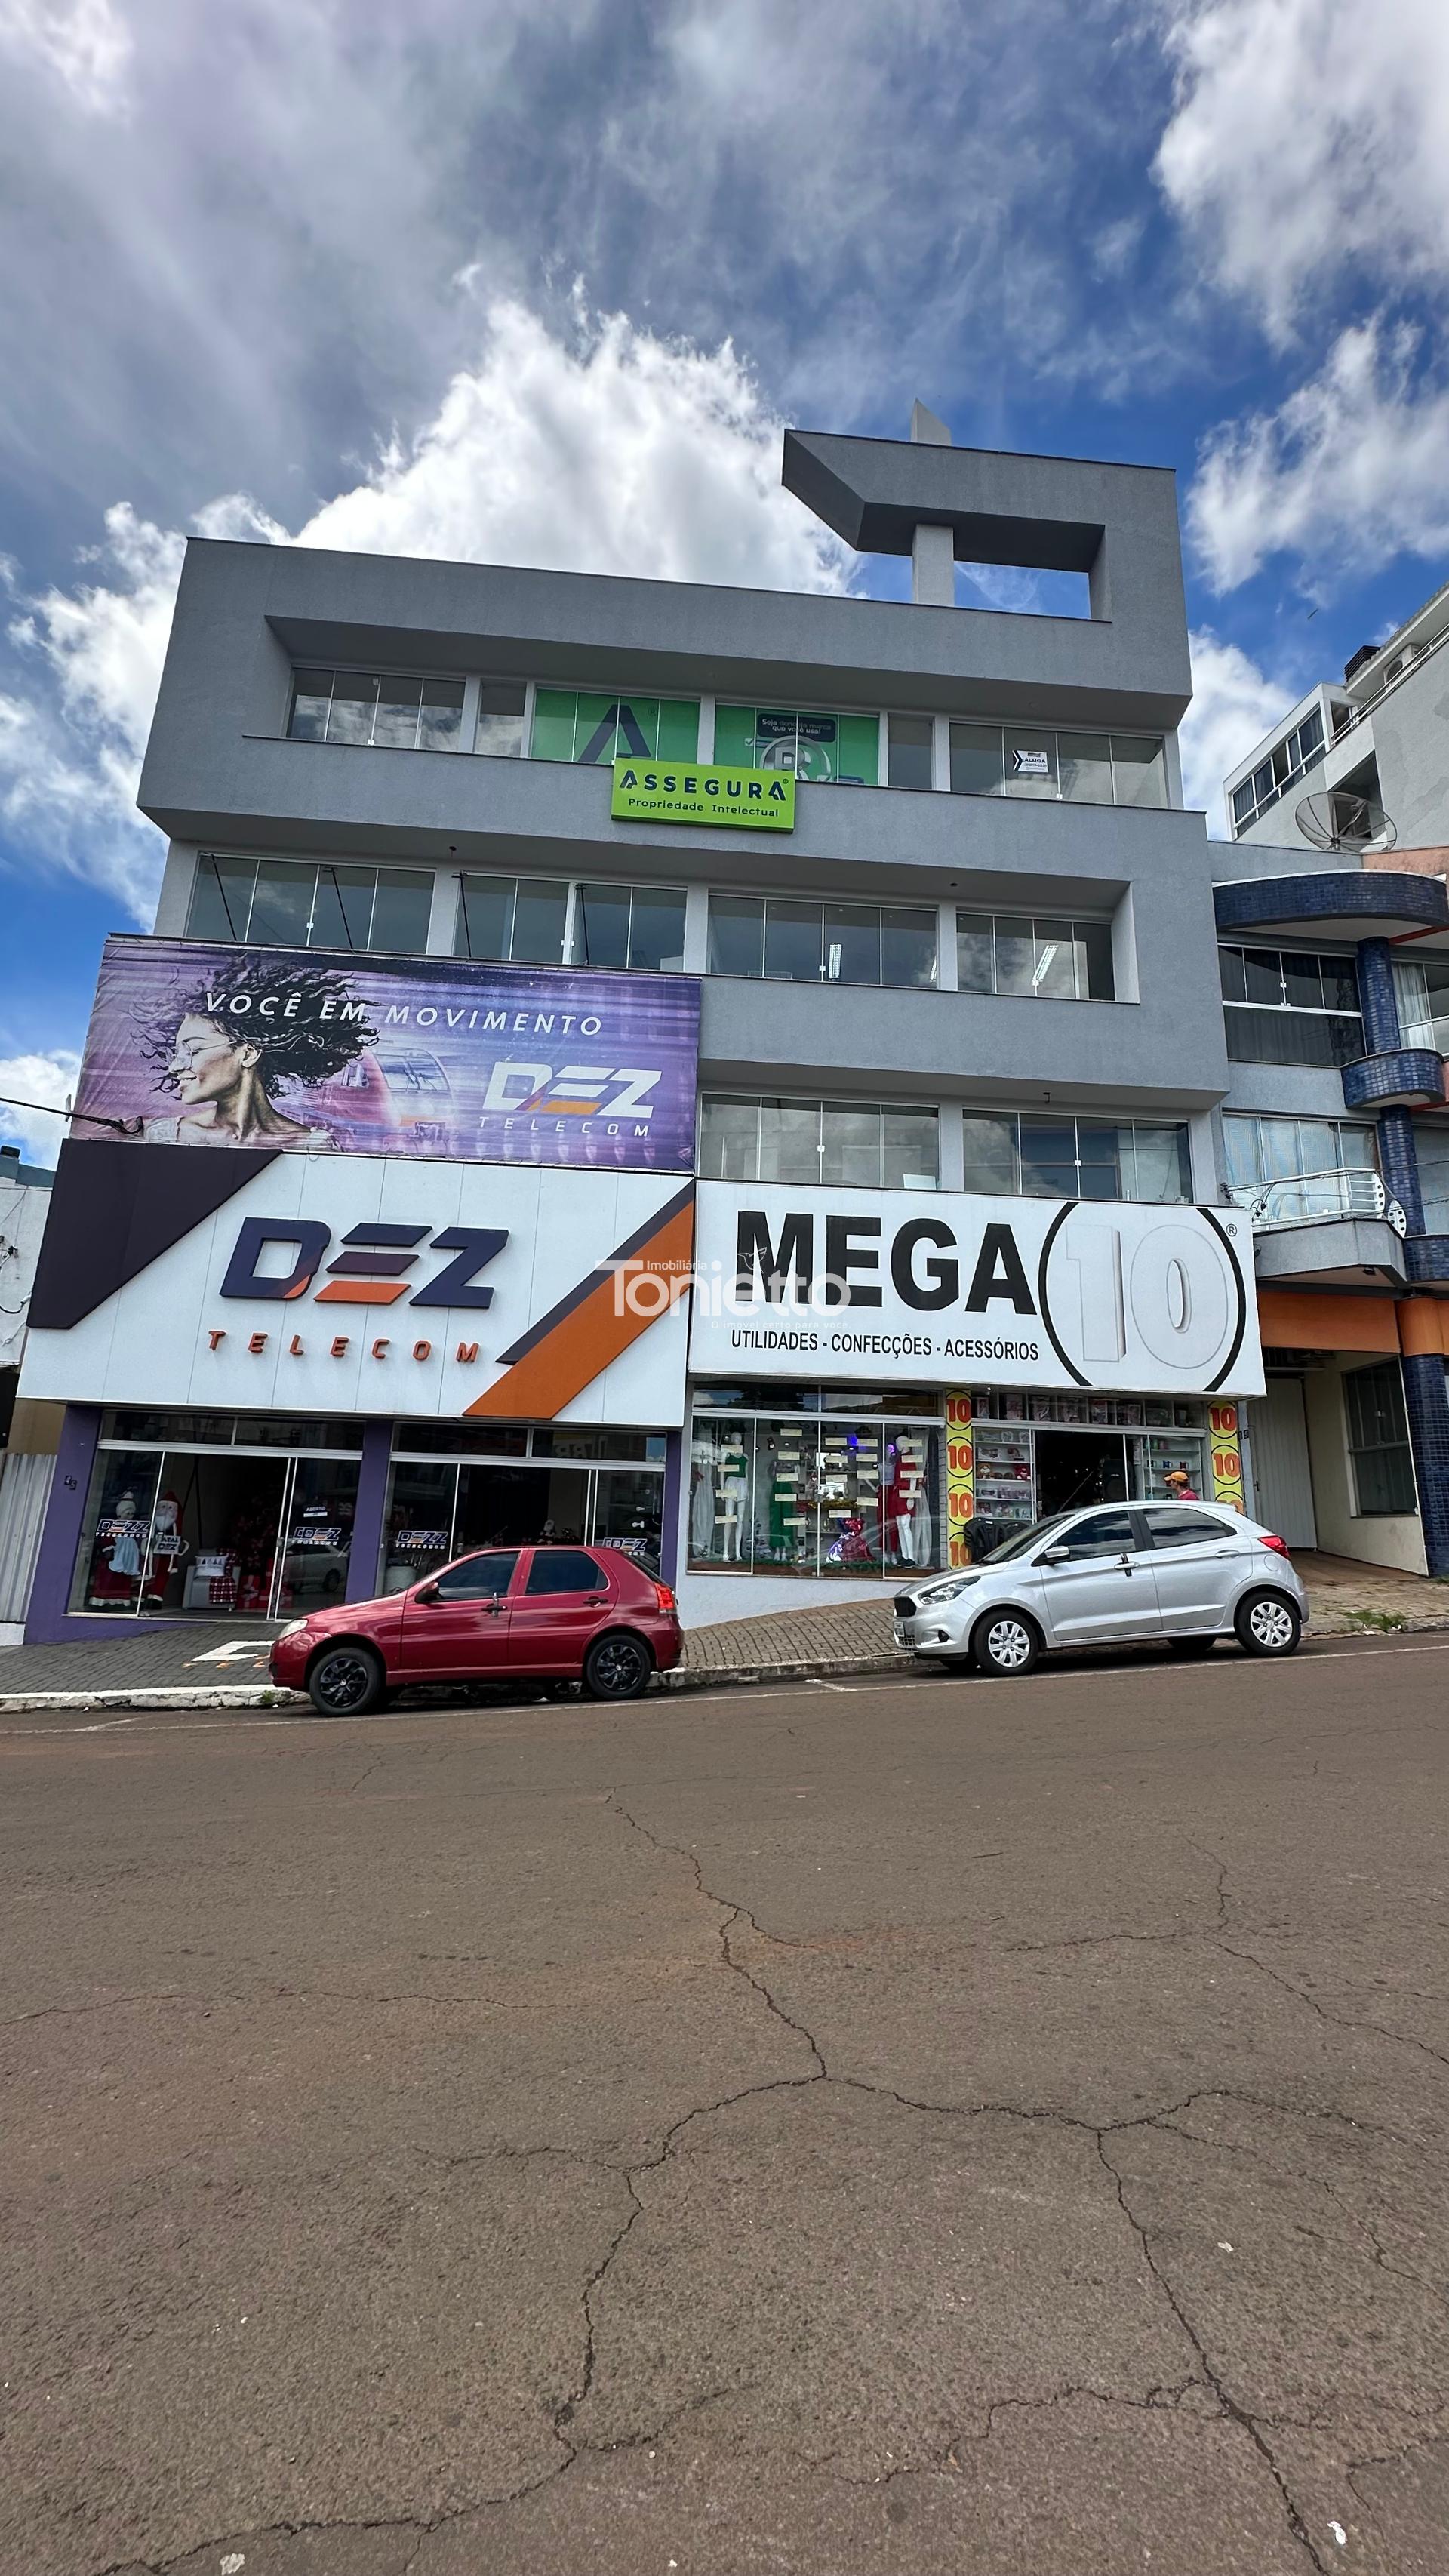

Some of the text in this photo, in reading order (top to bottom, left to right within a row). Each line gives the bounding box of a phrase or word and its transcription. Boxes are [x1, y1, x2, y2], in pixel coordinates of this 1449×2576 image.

[762, 719, 777, 727] Seja
[620, 770, 786, 801] ASSEGURA
[629, 798, 779, 817] Propriedade Intelectual
[206, 991, 602, 1036] VOCÊ EM MOVIMENTO
[482, 1061, 663, 1119] DEZ
[479, 1116, 649, 1137] TELECOM
[219, 1216, 510, 1310] DEZ
[735, 1209, 1038, 1316] MEGA
[1066, 1223, 1229, 1369] 10
[208, 1329, 480, 1363] TELECOM
[731, 1330, 818, 1351] UTILIDADES
[832, 1333, 932, 1359] CONFECÇÕES
[944, 1337, 1039, 1361] ACESSÓRIOS
[947, 1399, 971, 1423] 10
[1210, 1408, 1237, 1431] 10
[948, 1445, 973, 1470] 10
[1214, 1453, 1240, 1478] 10
[949, 1493, 974, 1518] 10
